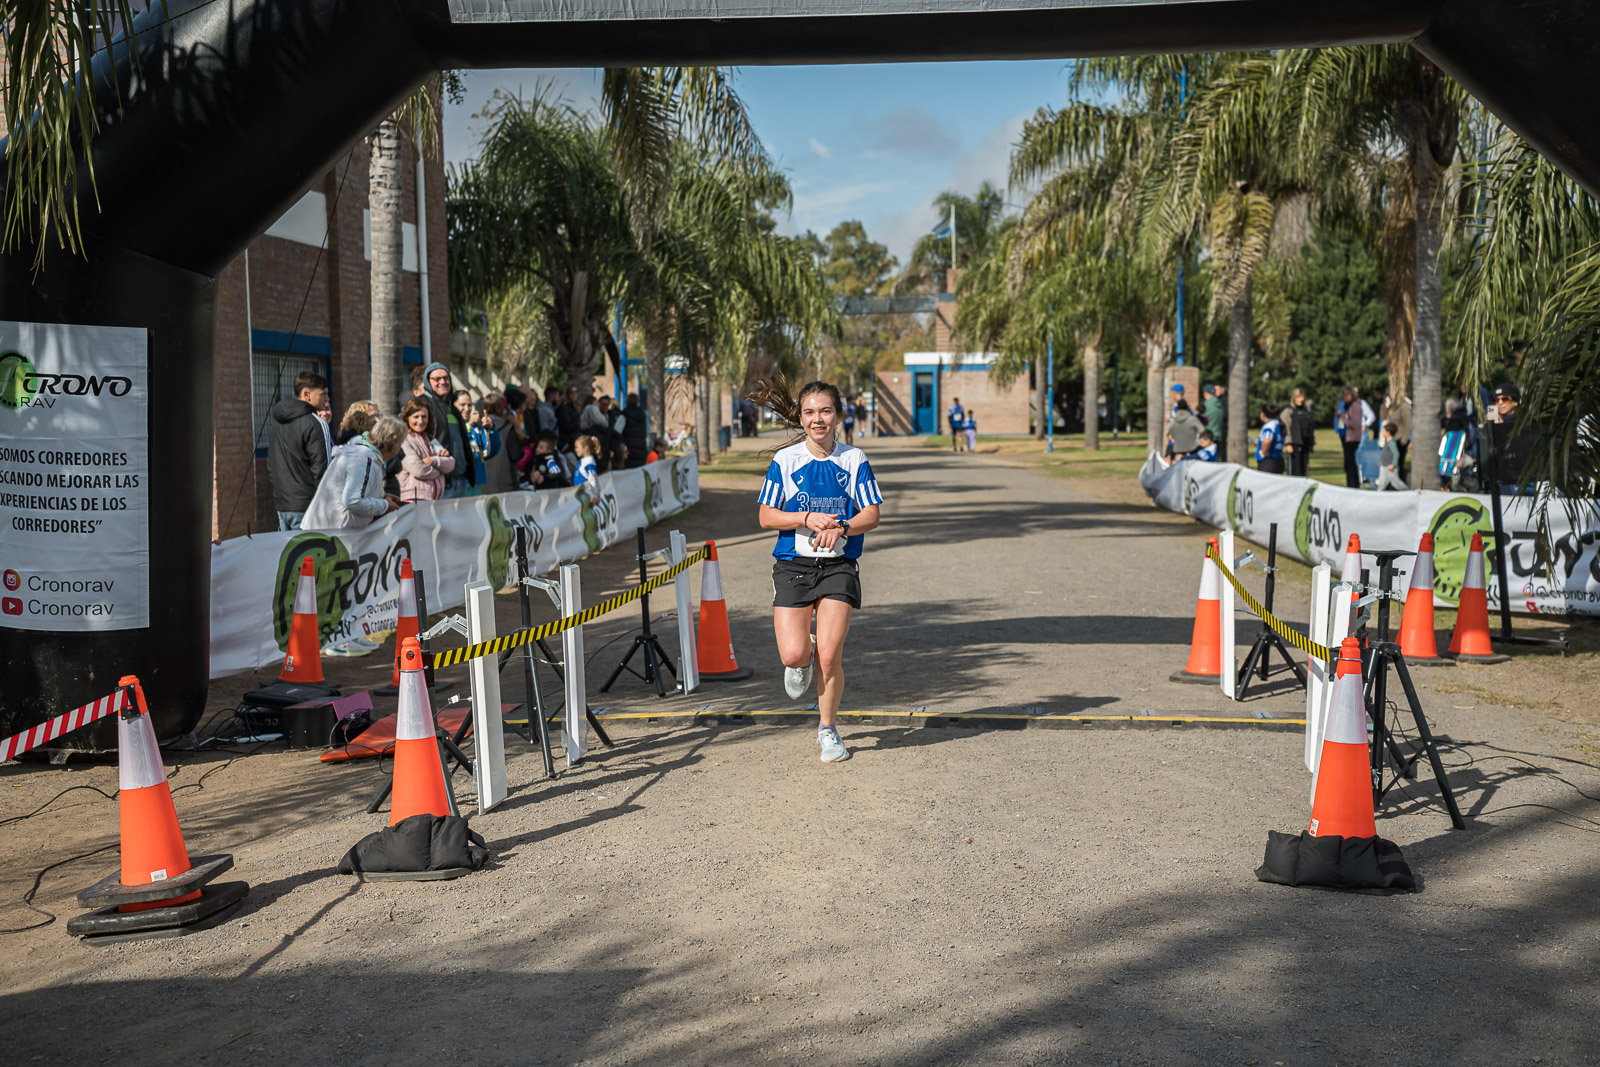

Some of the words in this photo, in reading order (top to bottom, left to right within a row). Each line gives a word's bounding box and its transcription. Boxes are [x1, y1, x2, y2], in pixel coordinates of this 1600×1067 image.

[22, 372, 132, 397] CRONO
[20, 396, 56, 409] RAV
[0, 447, 35, 464] SOMOS
[38, 450, 127, 466] CORREDORES
[46, 474, 111, 489] MEJORAR
[115, 474, 139, 488] LAS
[0, 491, 77, 511] XPERIENCIAS
[81, 497, 99, 511] DE
[102, 496, 127, 511] LOS
[28, 576, 115, 593] Cronorav
[28, 600, 115, 617] Cronorav
